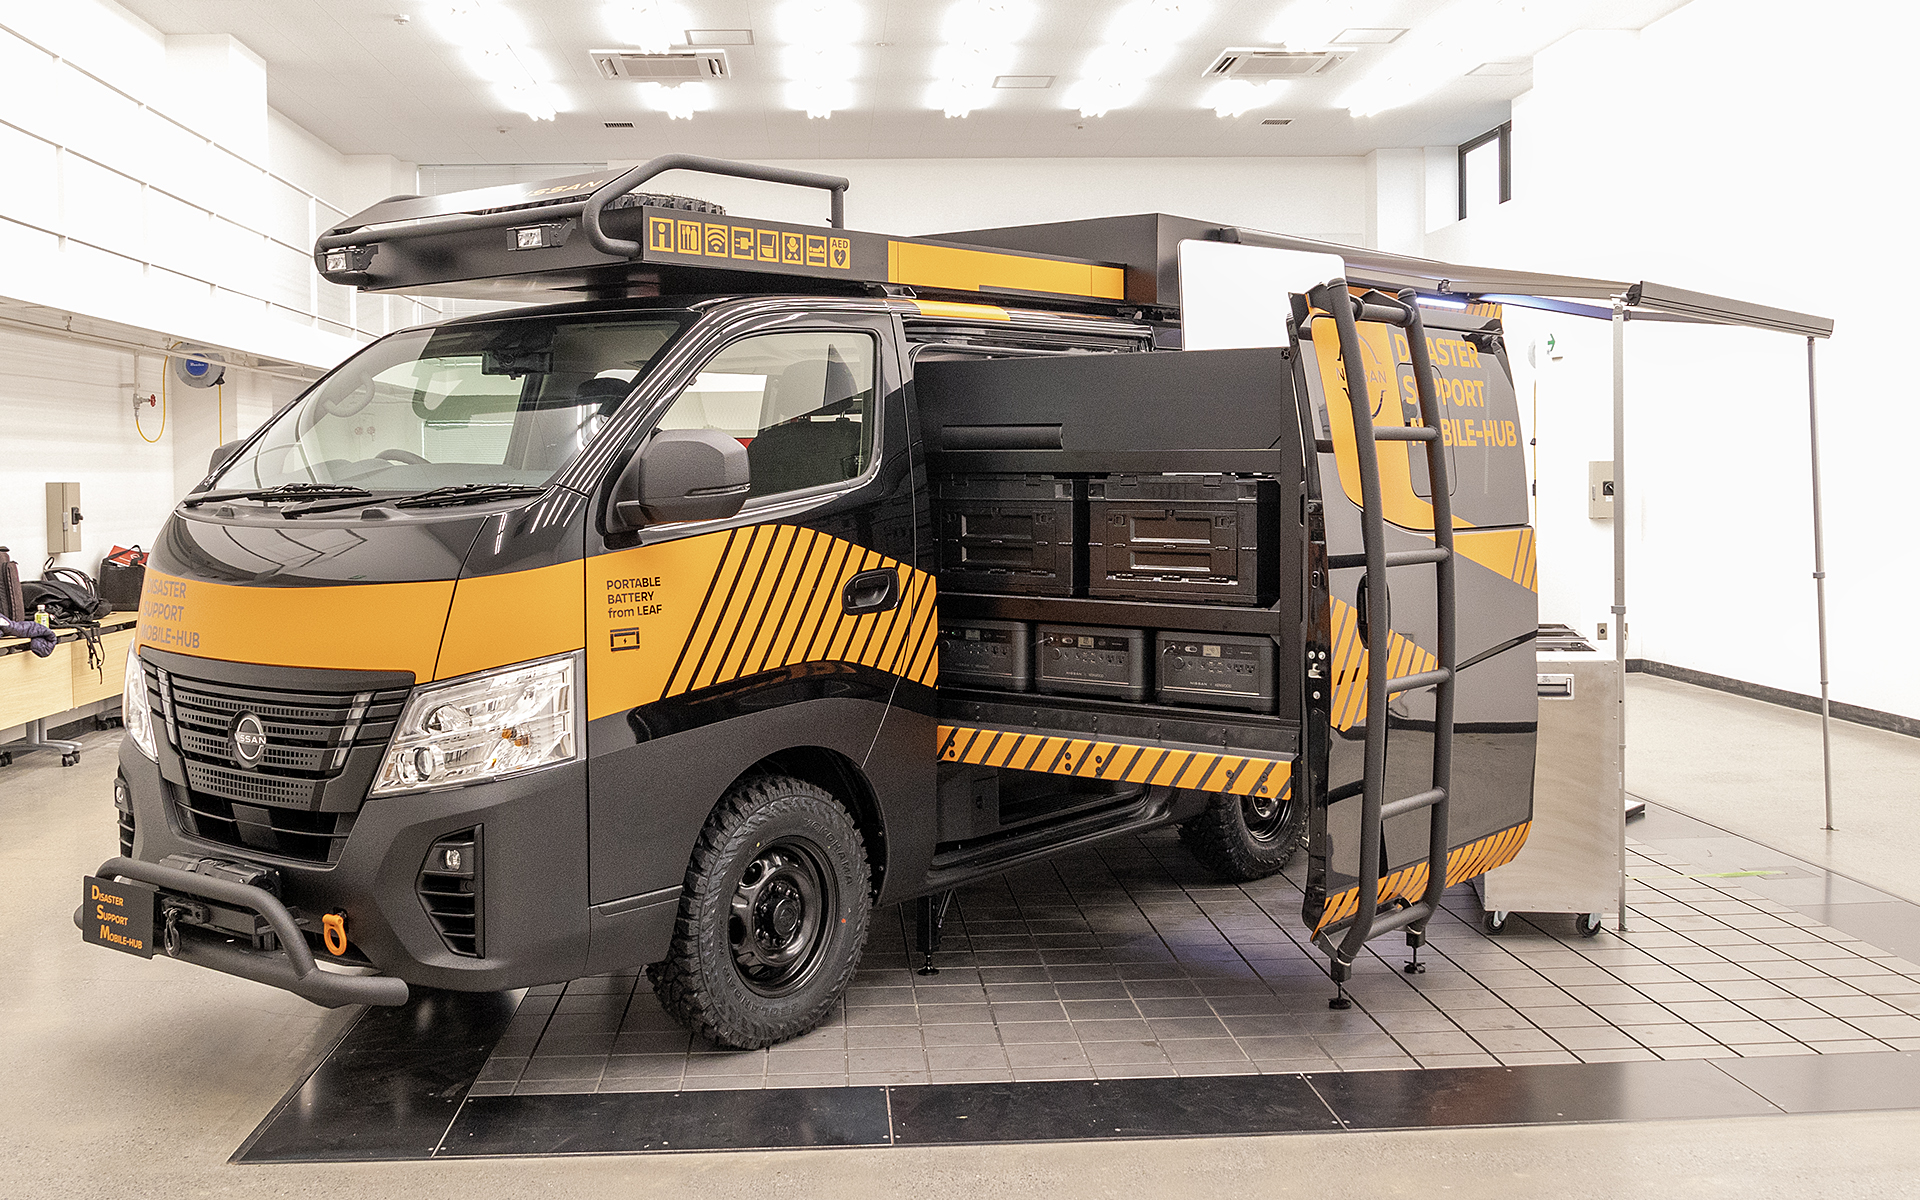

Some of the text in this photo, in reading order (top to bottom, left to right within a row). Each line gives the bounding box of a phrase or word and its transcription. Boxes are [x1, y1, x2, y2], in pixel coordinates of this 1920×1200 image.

[521, 179, 604, 197] ISSAN
[831, 239, 849, 249] AED
[1393, 333, 1482, 369] DASTER
[1335, 367, 1387, 384] NAN
[1402, 375, 1484, 407] SPORT
[1410, 417, 1517, 447] BILE-HUB
[147, 578, 187, 599] DISASTER
[606, 576, 661, 590] PORTABLE
[607, 591, 655, 605] BATTERY
[143, 600, 185, 622] SUPPORT
[608, 604, 662, 618] from LEAF
[141, 624, 200, 649] MOBILE-HUB
[236, 733, 266, 745] SSAN
[91, 884, 124, 907] DISASTER
[96, 904, 129, 926] SUPPORT
[99, 924, 143, 950] MOBILE-HUB
